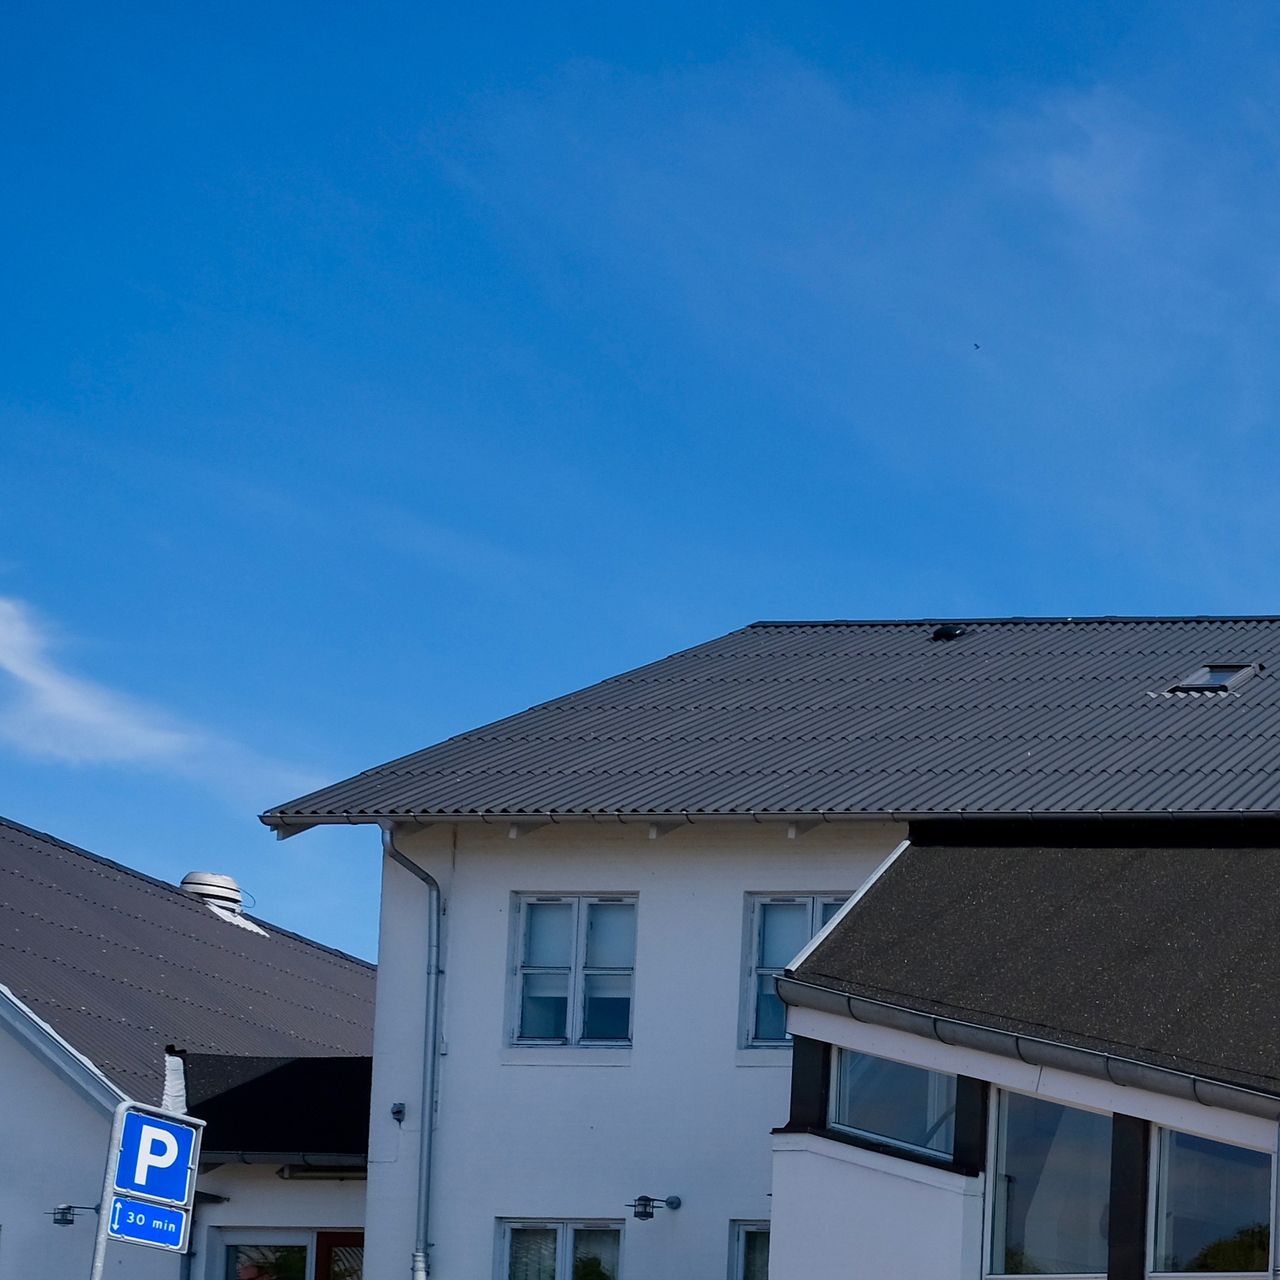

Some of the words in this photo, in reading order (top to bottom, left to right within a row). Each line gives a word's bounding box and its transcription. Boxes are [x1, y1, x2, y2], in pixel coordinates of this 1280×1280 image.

[134, 1125, 178, 1185] P
[126, 1212, 146, 1226] 30
[152, 1217, 176, 1233] min
